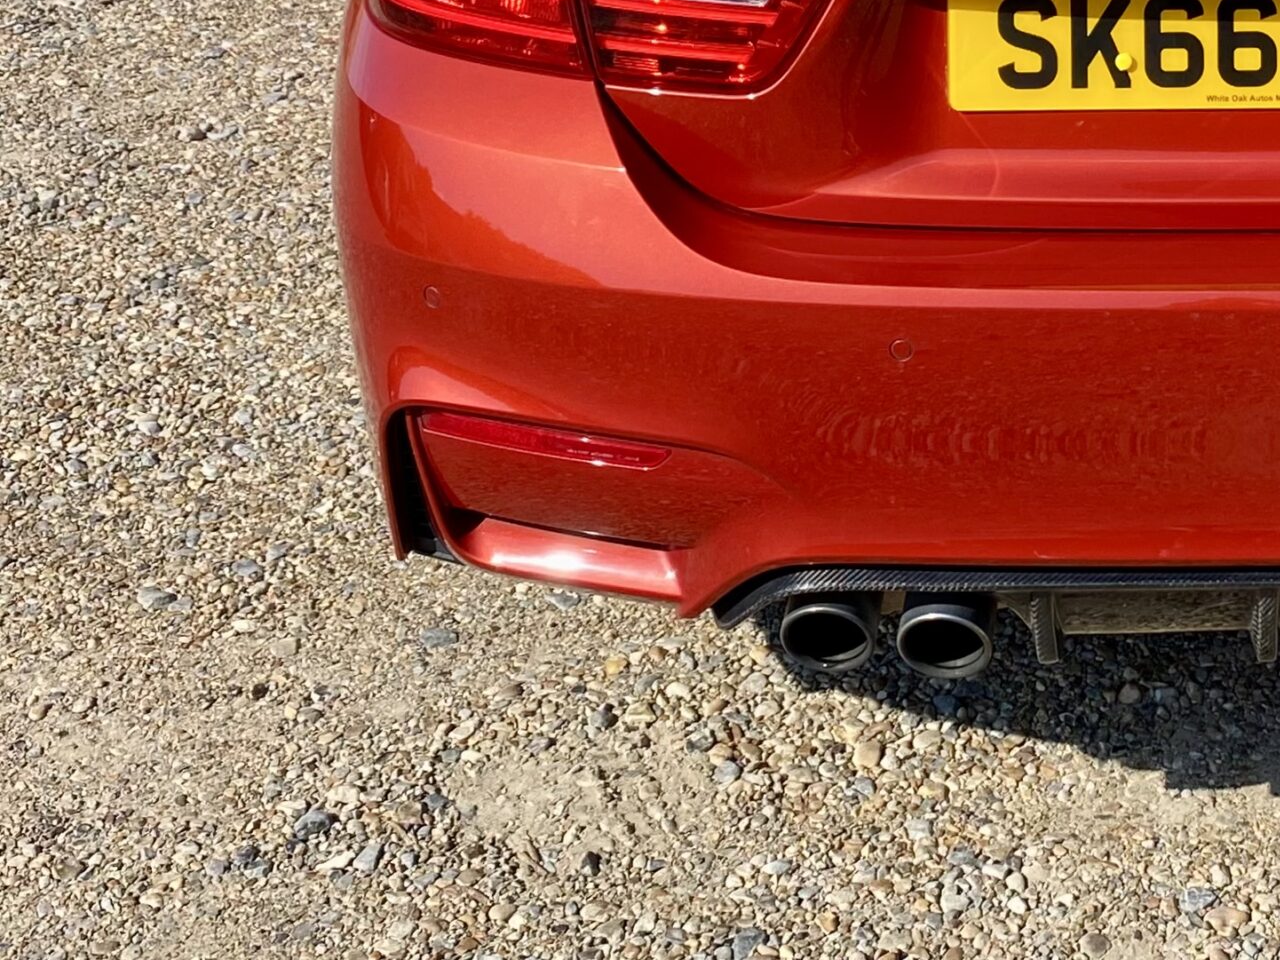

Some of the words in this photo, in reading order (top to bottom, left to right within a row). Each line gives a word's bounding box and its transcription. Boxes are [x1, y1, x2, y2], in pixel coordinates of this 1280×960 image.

[1206, 94, 1230, 103] White
[1231, 94, 1248, 103] Oak
[1249, 94, 1274, 102] Autos
